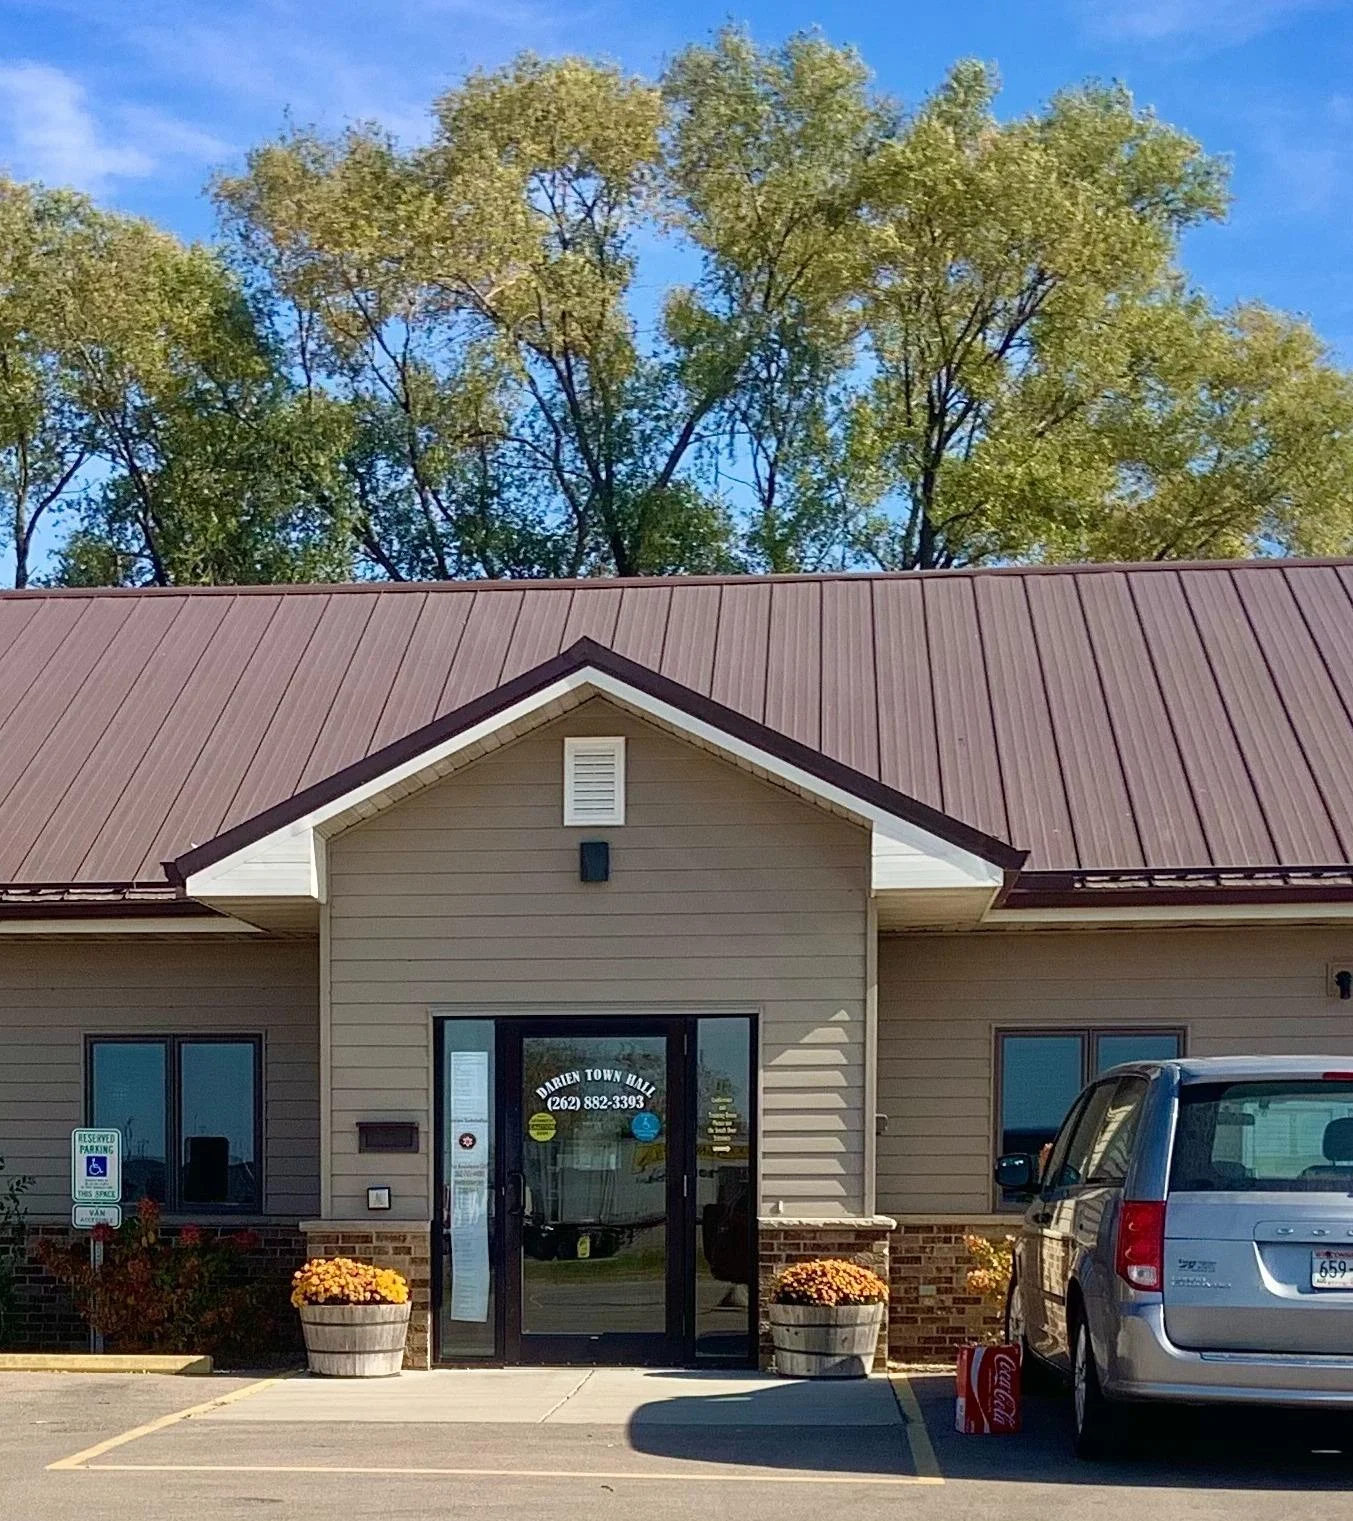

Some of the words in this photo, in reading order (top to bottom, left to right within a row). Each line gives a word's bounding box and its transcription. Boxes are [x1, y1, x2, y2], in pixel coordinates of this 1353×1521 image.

[535, 1070, 581, 1100] DARIEN
[585, 1068, 623, 1082] TOWN
[625, 1072, 657, 1098] HALL
[547, 1096, 581, 1111] (262)
[584, 1095, 645, 1109] 882-3393
[78, 1134, 115, 1144] RESERVED
[79, 1145, 114, 1155] PARKING
